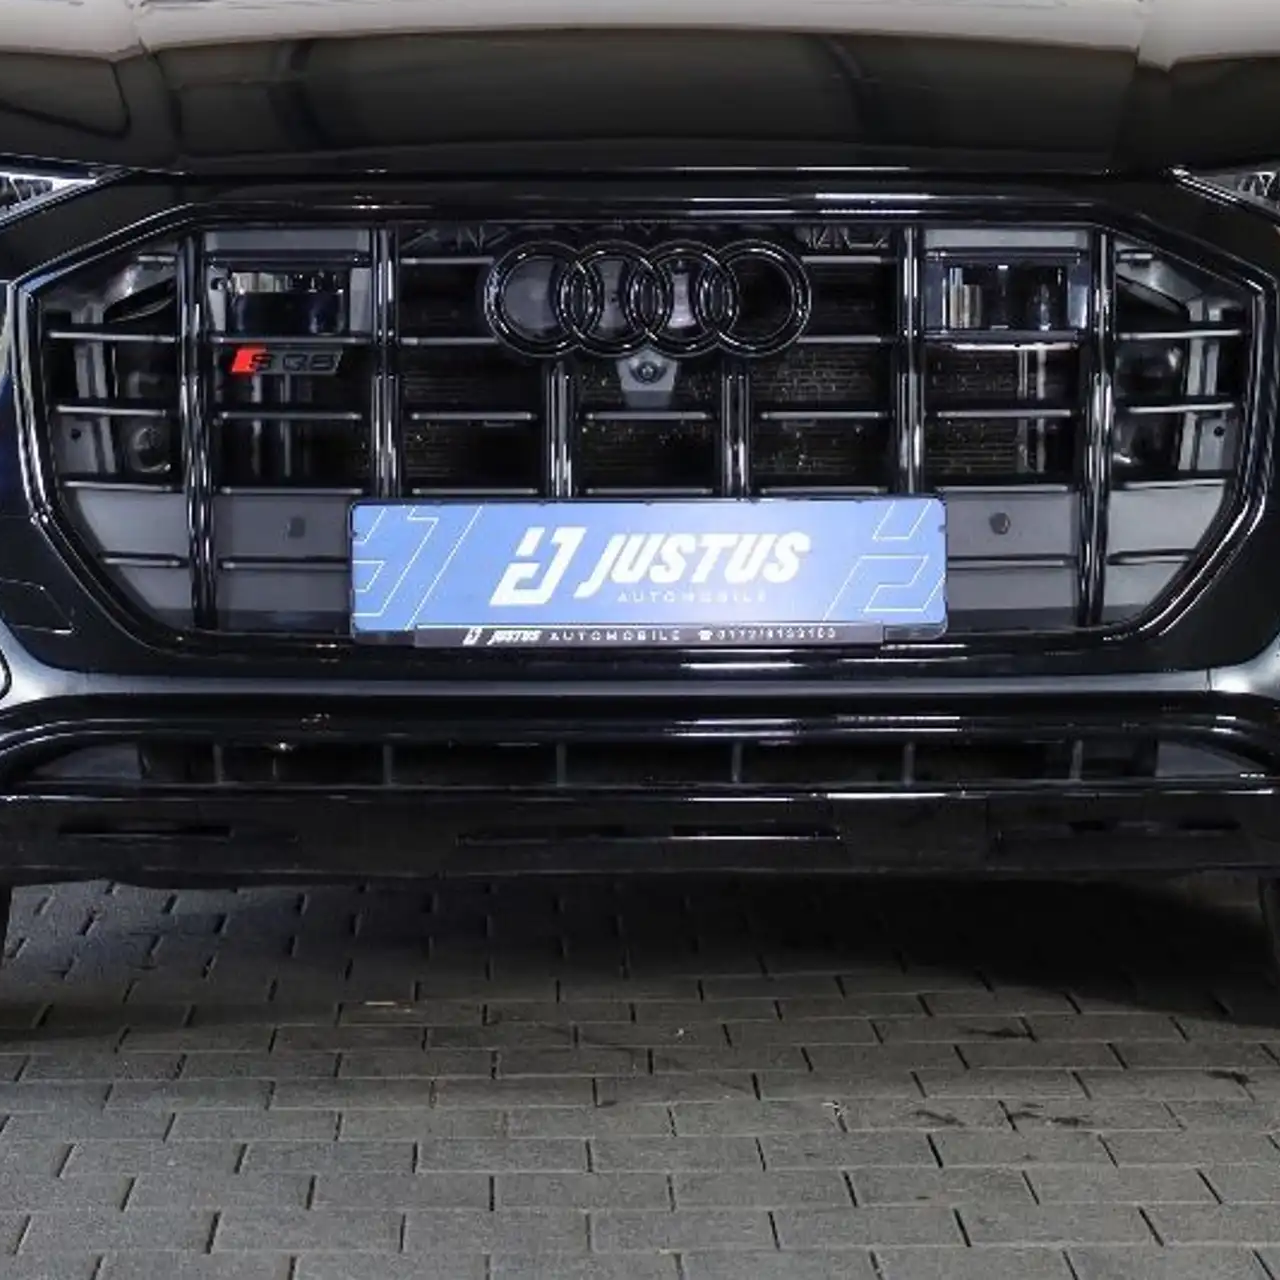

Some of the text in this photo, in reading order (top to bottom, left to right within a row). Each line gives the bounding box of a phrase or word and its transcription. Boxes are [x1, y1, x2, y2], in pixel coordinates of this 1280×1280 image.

[574, 531, 812, 598] JUSTUS
[617, 590, 767, 604] AUTOMOBILE
[487, 629, 542, 646] JUSTUS
[548, 630, 681, 642] AUTOMOBILE
